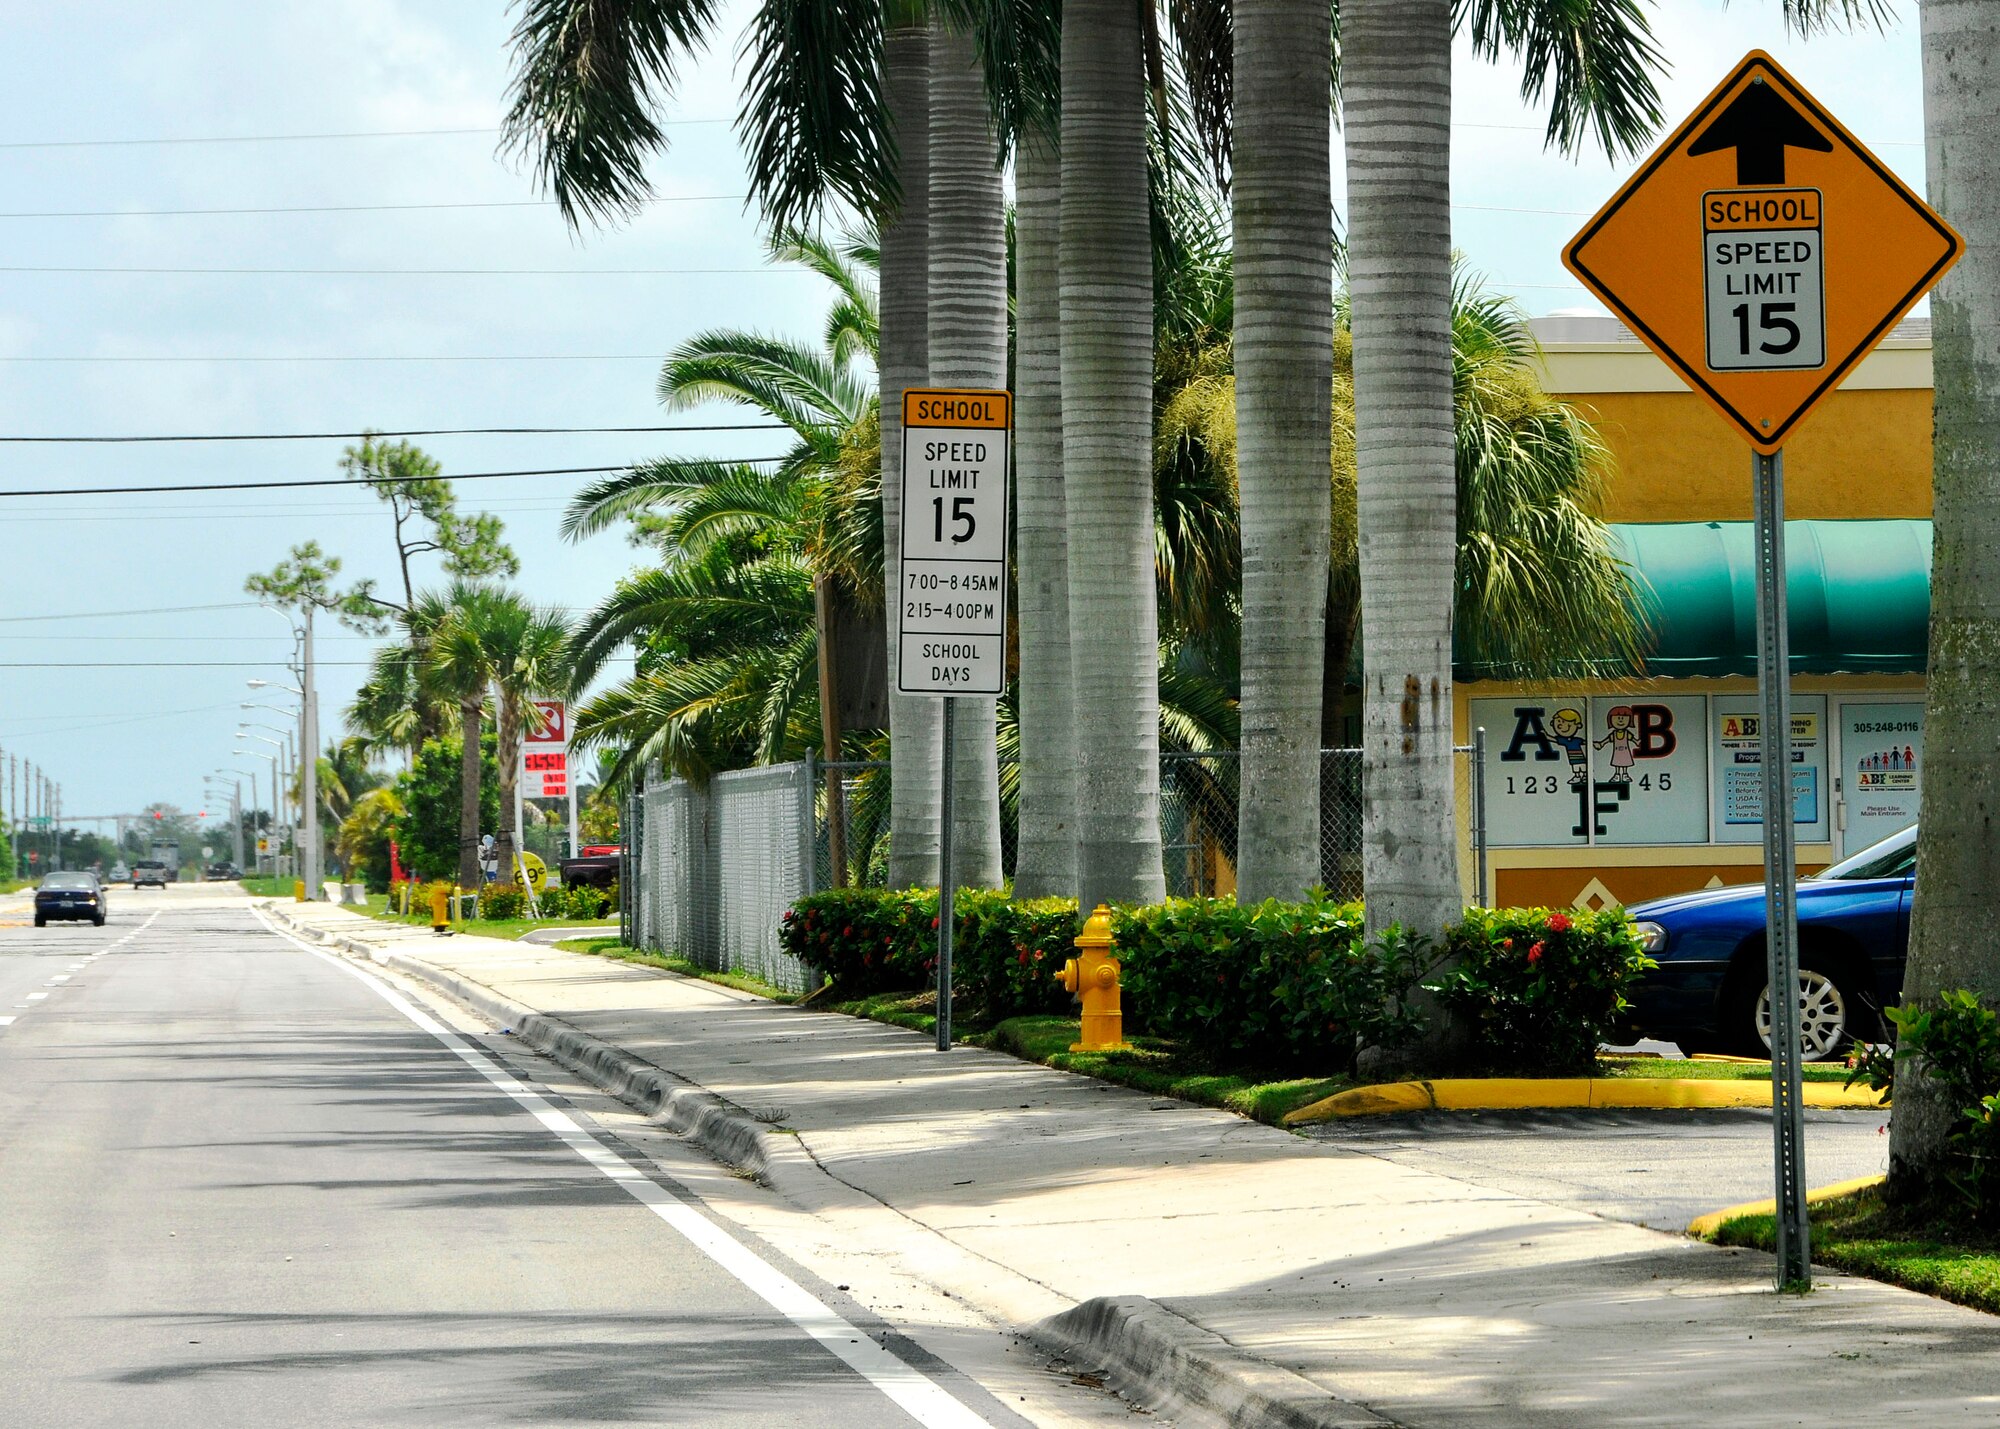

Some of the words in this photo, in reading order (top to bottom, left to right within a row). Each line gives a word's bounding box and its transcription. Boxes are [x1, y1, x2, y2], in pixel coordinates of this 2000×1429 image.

[1710, 199, 1815, 223] SCHOOL
[1716, 241, 1811, 265] SPEED
[1726, 272, 1801, 296] LIMIT
[1732, 302, 1801, 355] 15
[918, 400, 995, 421] SCHOOL
[924, 442, 986, 462] SPEED
[930, 469, 980, 489] LIMIT
[932, 496, 976, 543] 15
[922, 643, 980, 660] SCHOOL
[932, 666, 970, 681] DAYS
[1500, 707, 1560, 762] A
[1631, 704, 1677, 759] B
[1853, 721, 1919, 733] 305-248-0116
[1738, 753, 1760, 762] Progra
[1859, 772, 1887, 785] ABF
[1571, 781, 1631, 836] F
